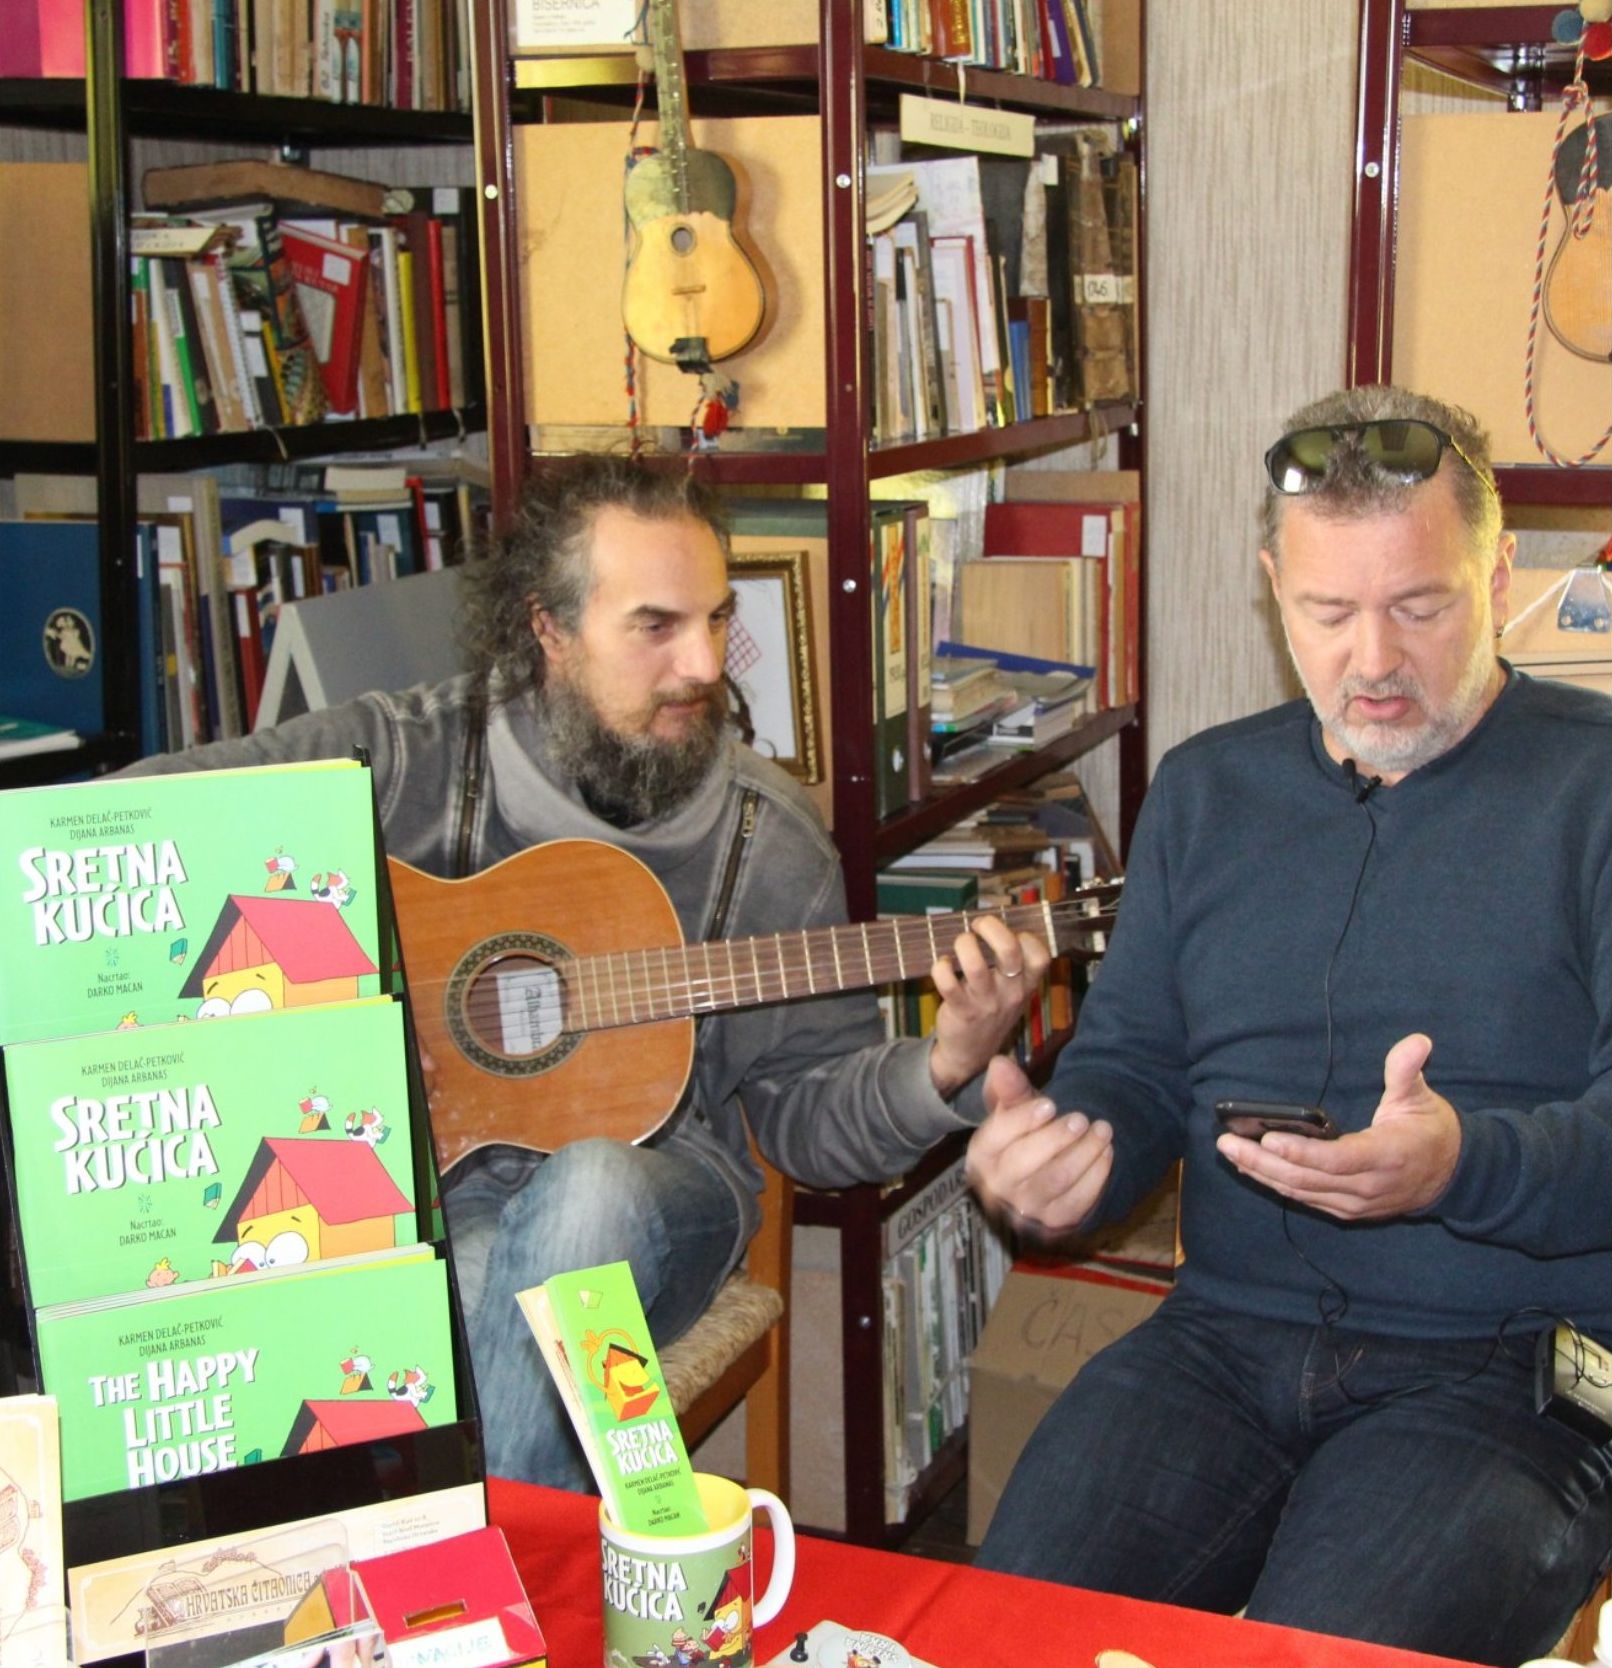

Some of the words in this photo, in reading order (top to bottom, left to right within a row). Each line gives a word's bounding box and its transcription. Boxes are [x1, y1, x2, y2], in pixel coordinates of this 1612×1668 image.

[50, 813, 84, 828] KARMEN
[85, 808, 152, 825] DELAČ-PETKOVIĆ
[69, 826, 96, 840] DIJANA
[98, 823, 135, 837] ARBANAS
[19, 840, 188, 903] SRETNA
[34, 882, 185, 946] KUĆICA
[87, 985, 114, 999] DARKO
[116, 981, 143, 996] MACAN
[81, 1061, 116, 1076] KARMEN
[118, 1053, 184, 1070] DELAČ-PETKOVIĆ
[101, 1074, 128, 1087] DIJANA
[131, 1070, 168, 1083] ARBANAS
[50, 1083, 222, 1153] SRETNA
[65, 1130, 219, 1195] KUĆICA
[119, 1232, 147, 1246] DARKO
[149, 1227, 177, 1242] MACAN
[118, 1330, 153, 1346] KARMEN
[155, 1317, 223, 1339] DELAČ-PETKOVIĆ
[139, 1343, 167, 1357] DIJANA
[169, 1335, 206, 1351] ARBANAS
[89, 1372, 142, 1408] THE
[146, 1347, 260, 1402] HAPPY
[123, 1393, 236, 1449] LITTLE
[606, 1419, 674, 1457] SRETNA
[127, 1434, 239, 1489] HOUSE
[601, 1538, 688, 1592] SRETNA
[186, 1585, 248, 1617] HRVATSKA
[251, 1570, 310, 1602] ČITAONICA
[604, 1573, 684, 1621] KUĆICA
